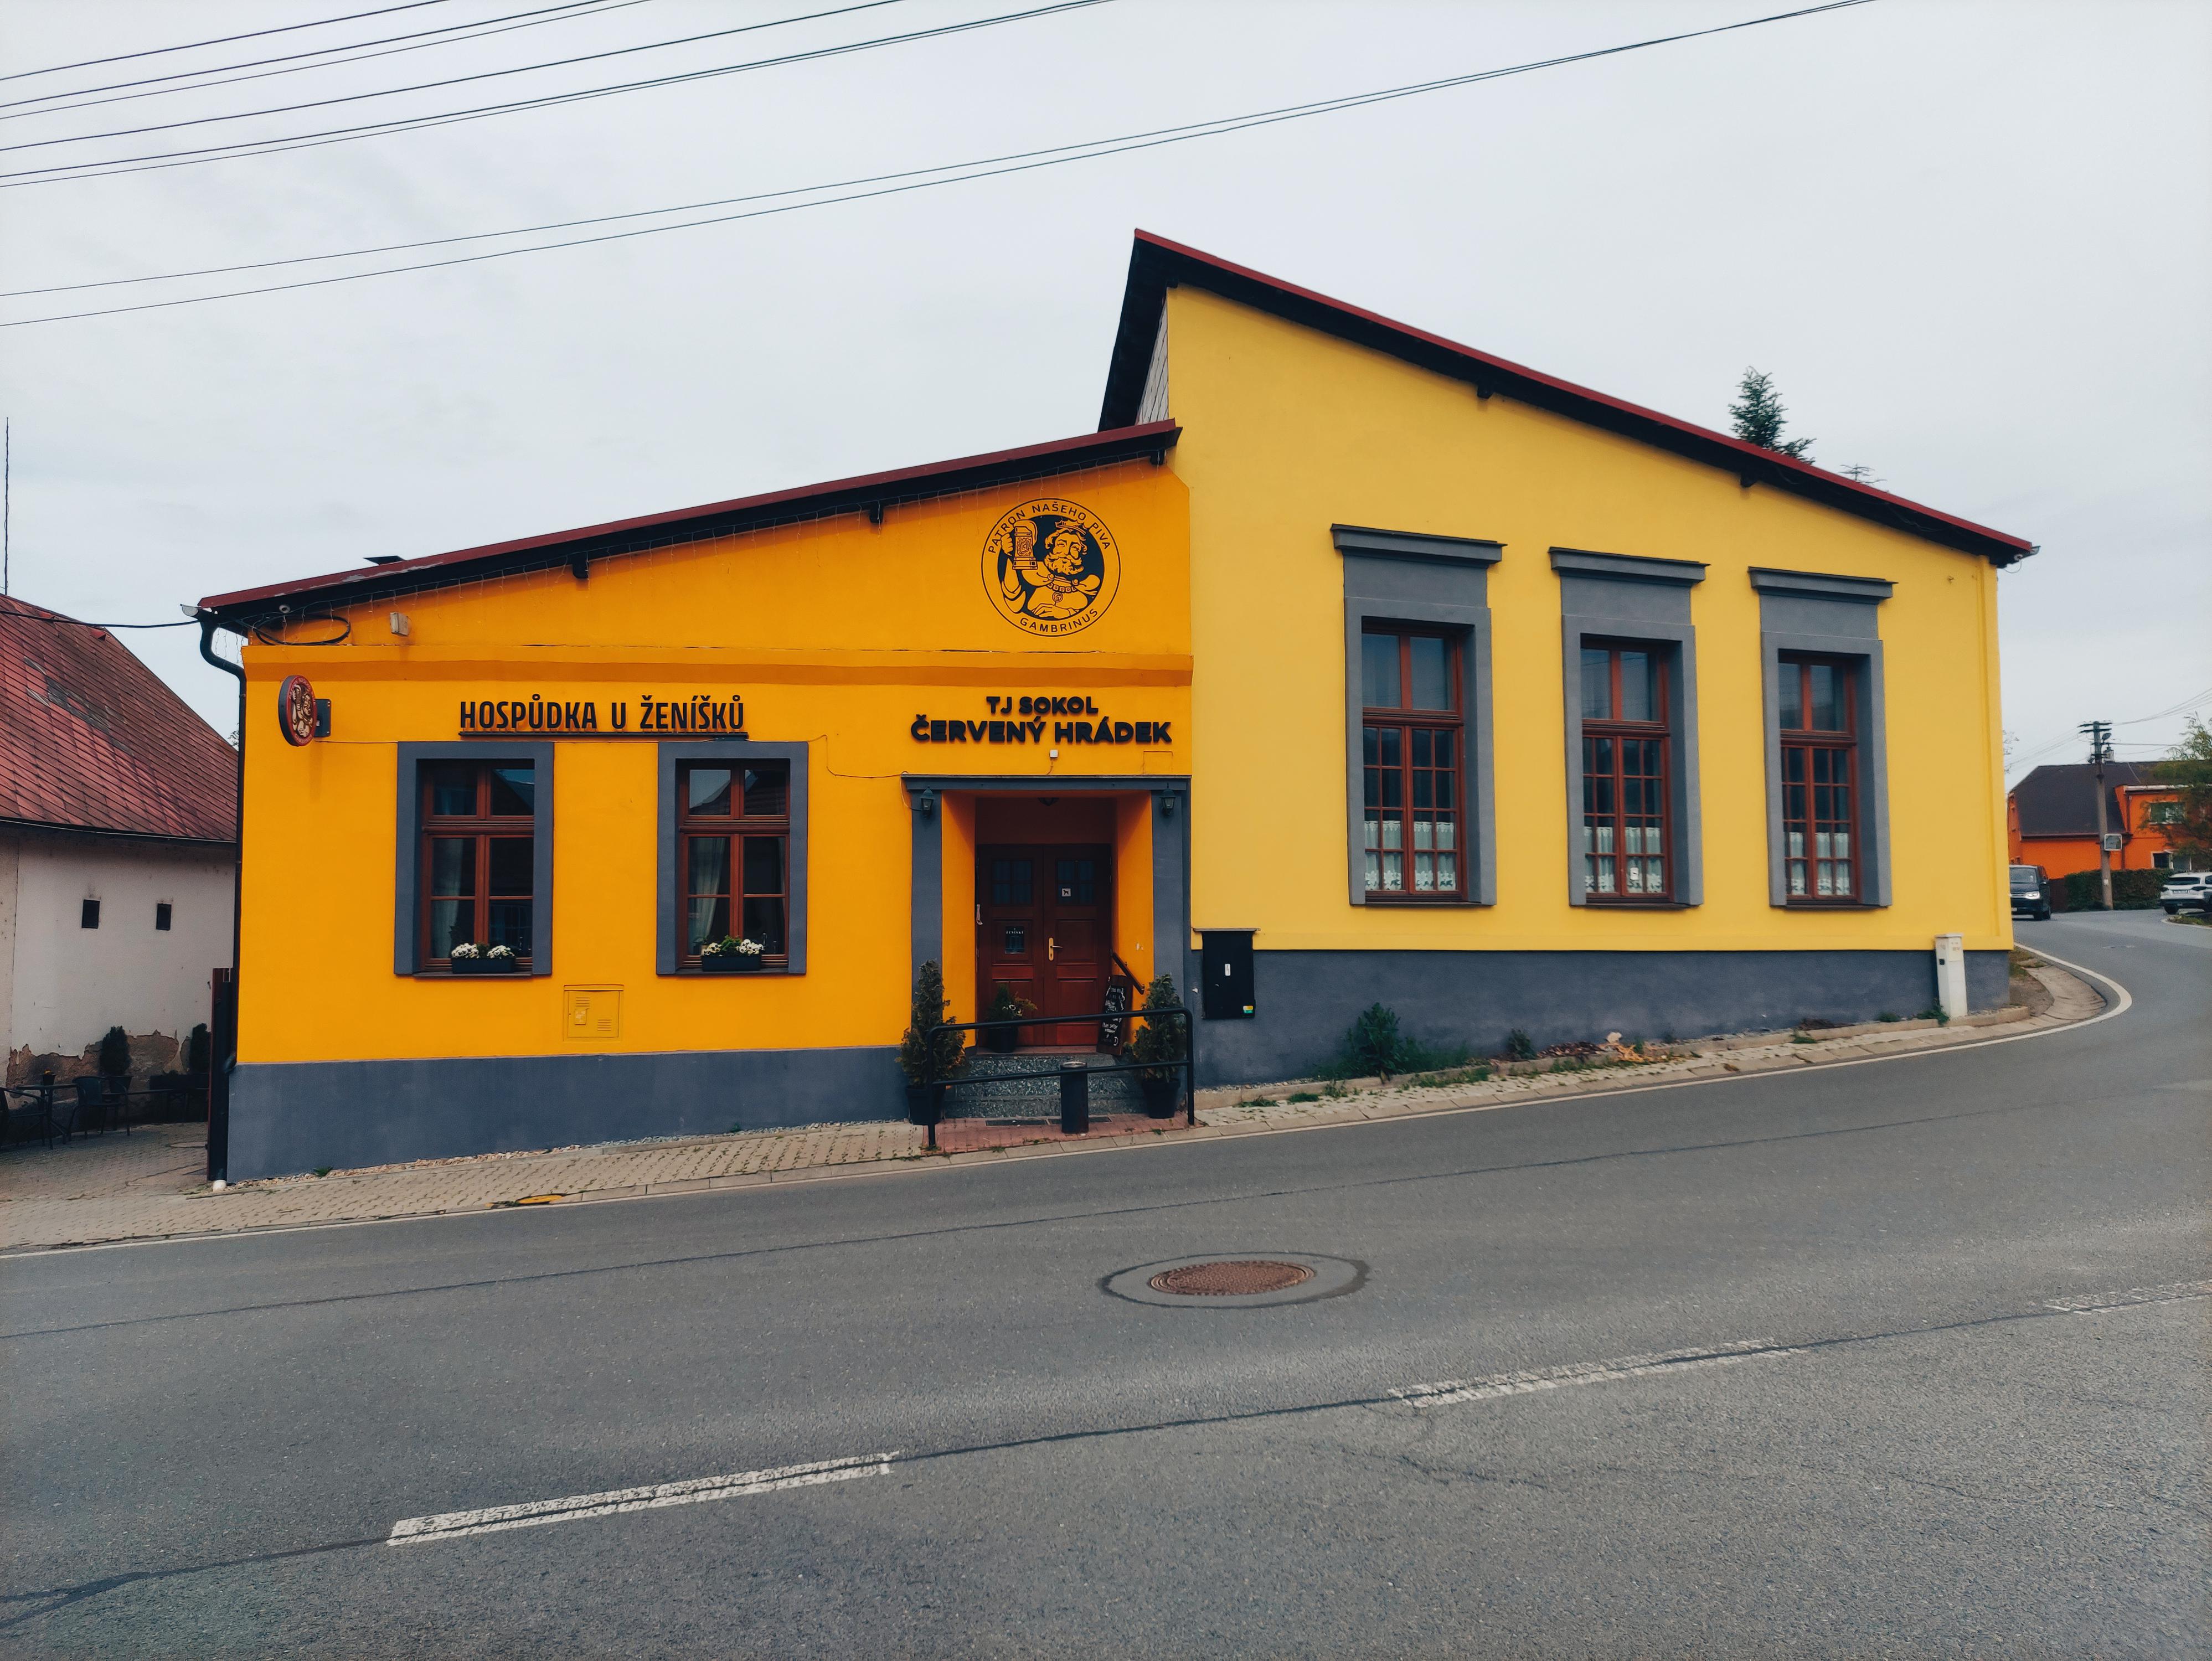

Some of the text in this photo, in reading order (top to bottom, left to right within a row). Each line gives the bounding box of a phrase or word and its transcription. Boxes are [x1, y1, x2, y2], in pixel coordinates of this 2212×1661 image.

[988, 502, 1111, 553] PATRON NAŠEHO PIVA
[1020, 609, 1098, 632] GAMBRINUS
[460, 694, 744, 730] HOSPŮDKA U ŽENÍŠKŮ
[986, 696, 1099, 716] TJ SOKOL
[910, 714, 1172, 744] ČERVENÝ HRÁDEK
